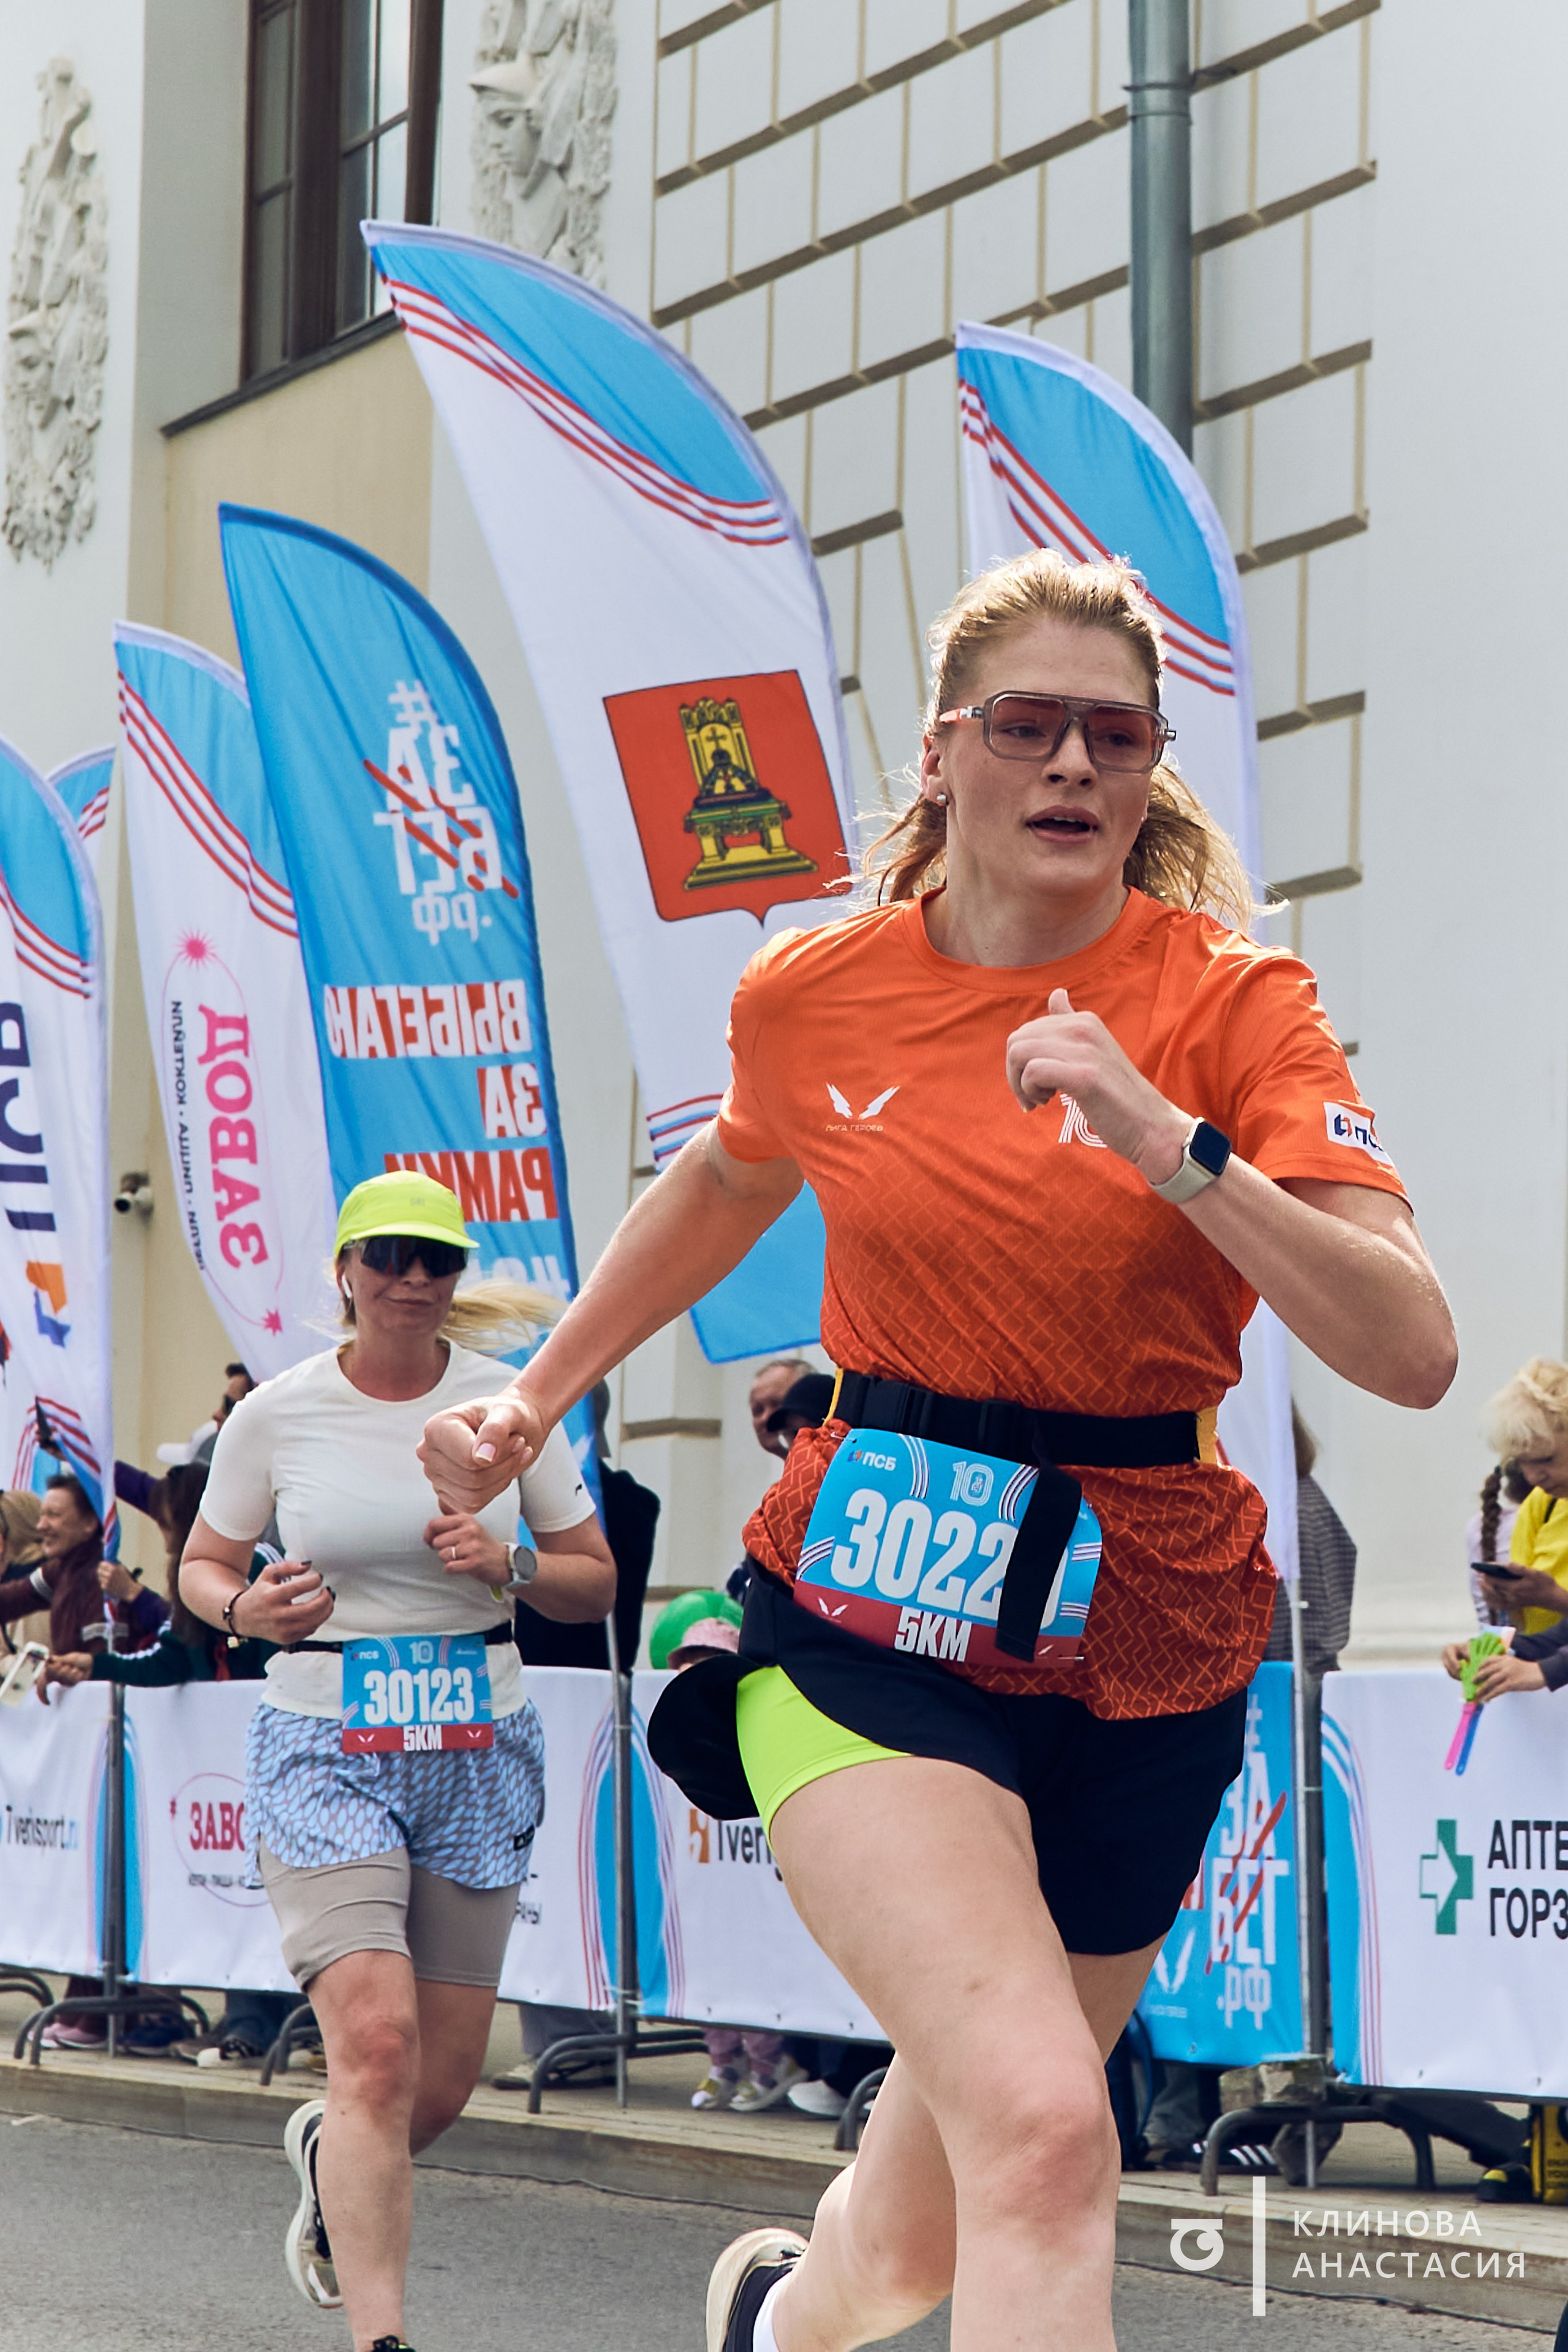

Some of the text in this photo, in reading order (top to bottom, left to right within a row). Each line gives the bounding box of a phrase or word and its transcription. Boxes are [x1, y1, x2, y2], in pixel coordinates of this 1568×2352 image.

[863, 1450, 897, 1471] ПСБ
[950, 1461, 994, 1506] 10
[363, 1667, 475, 1725] 30123
[1487, 1819, 1568, 1871] АПТЕ
[1210, 1857, 1289, 1965] БЕГ
